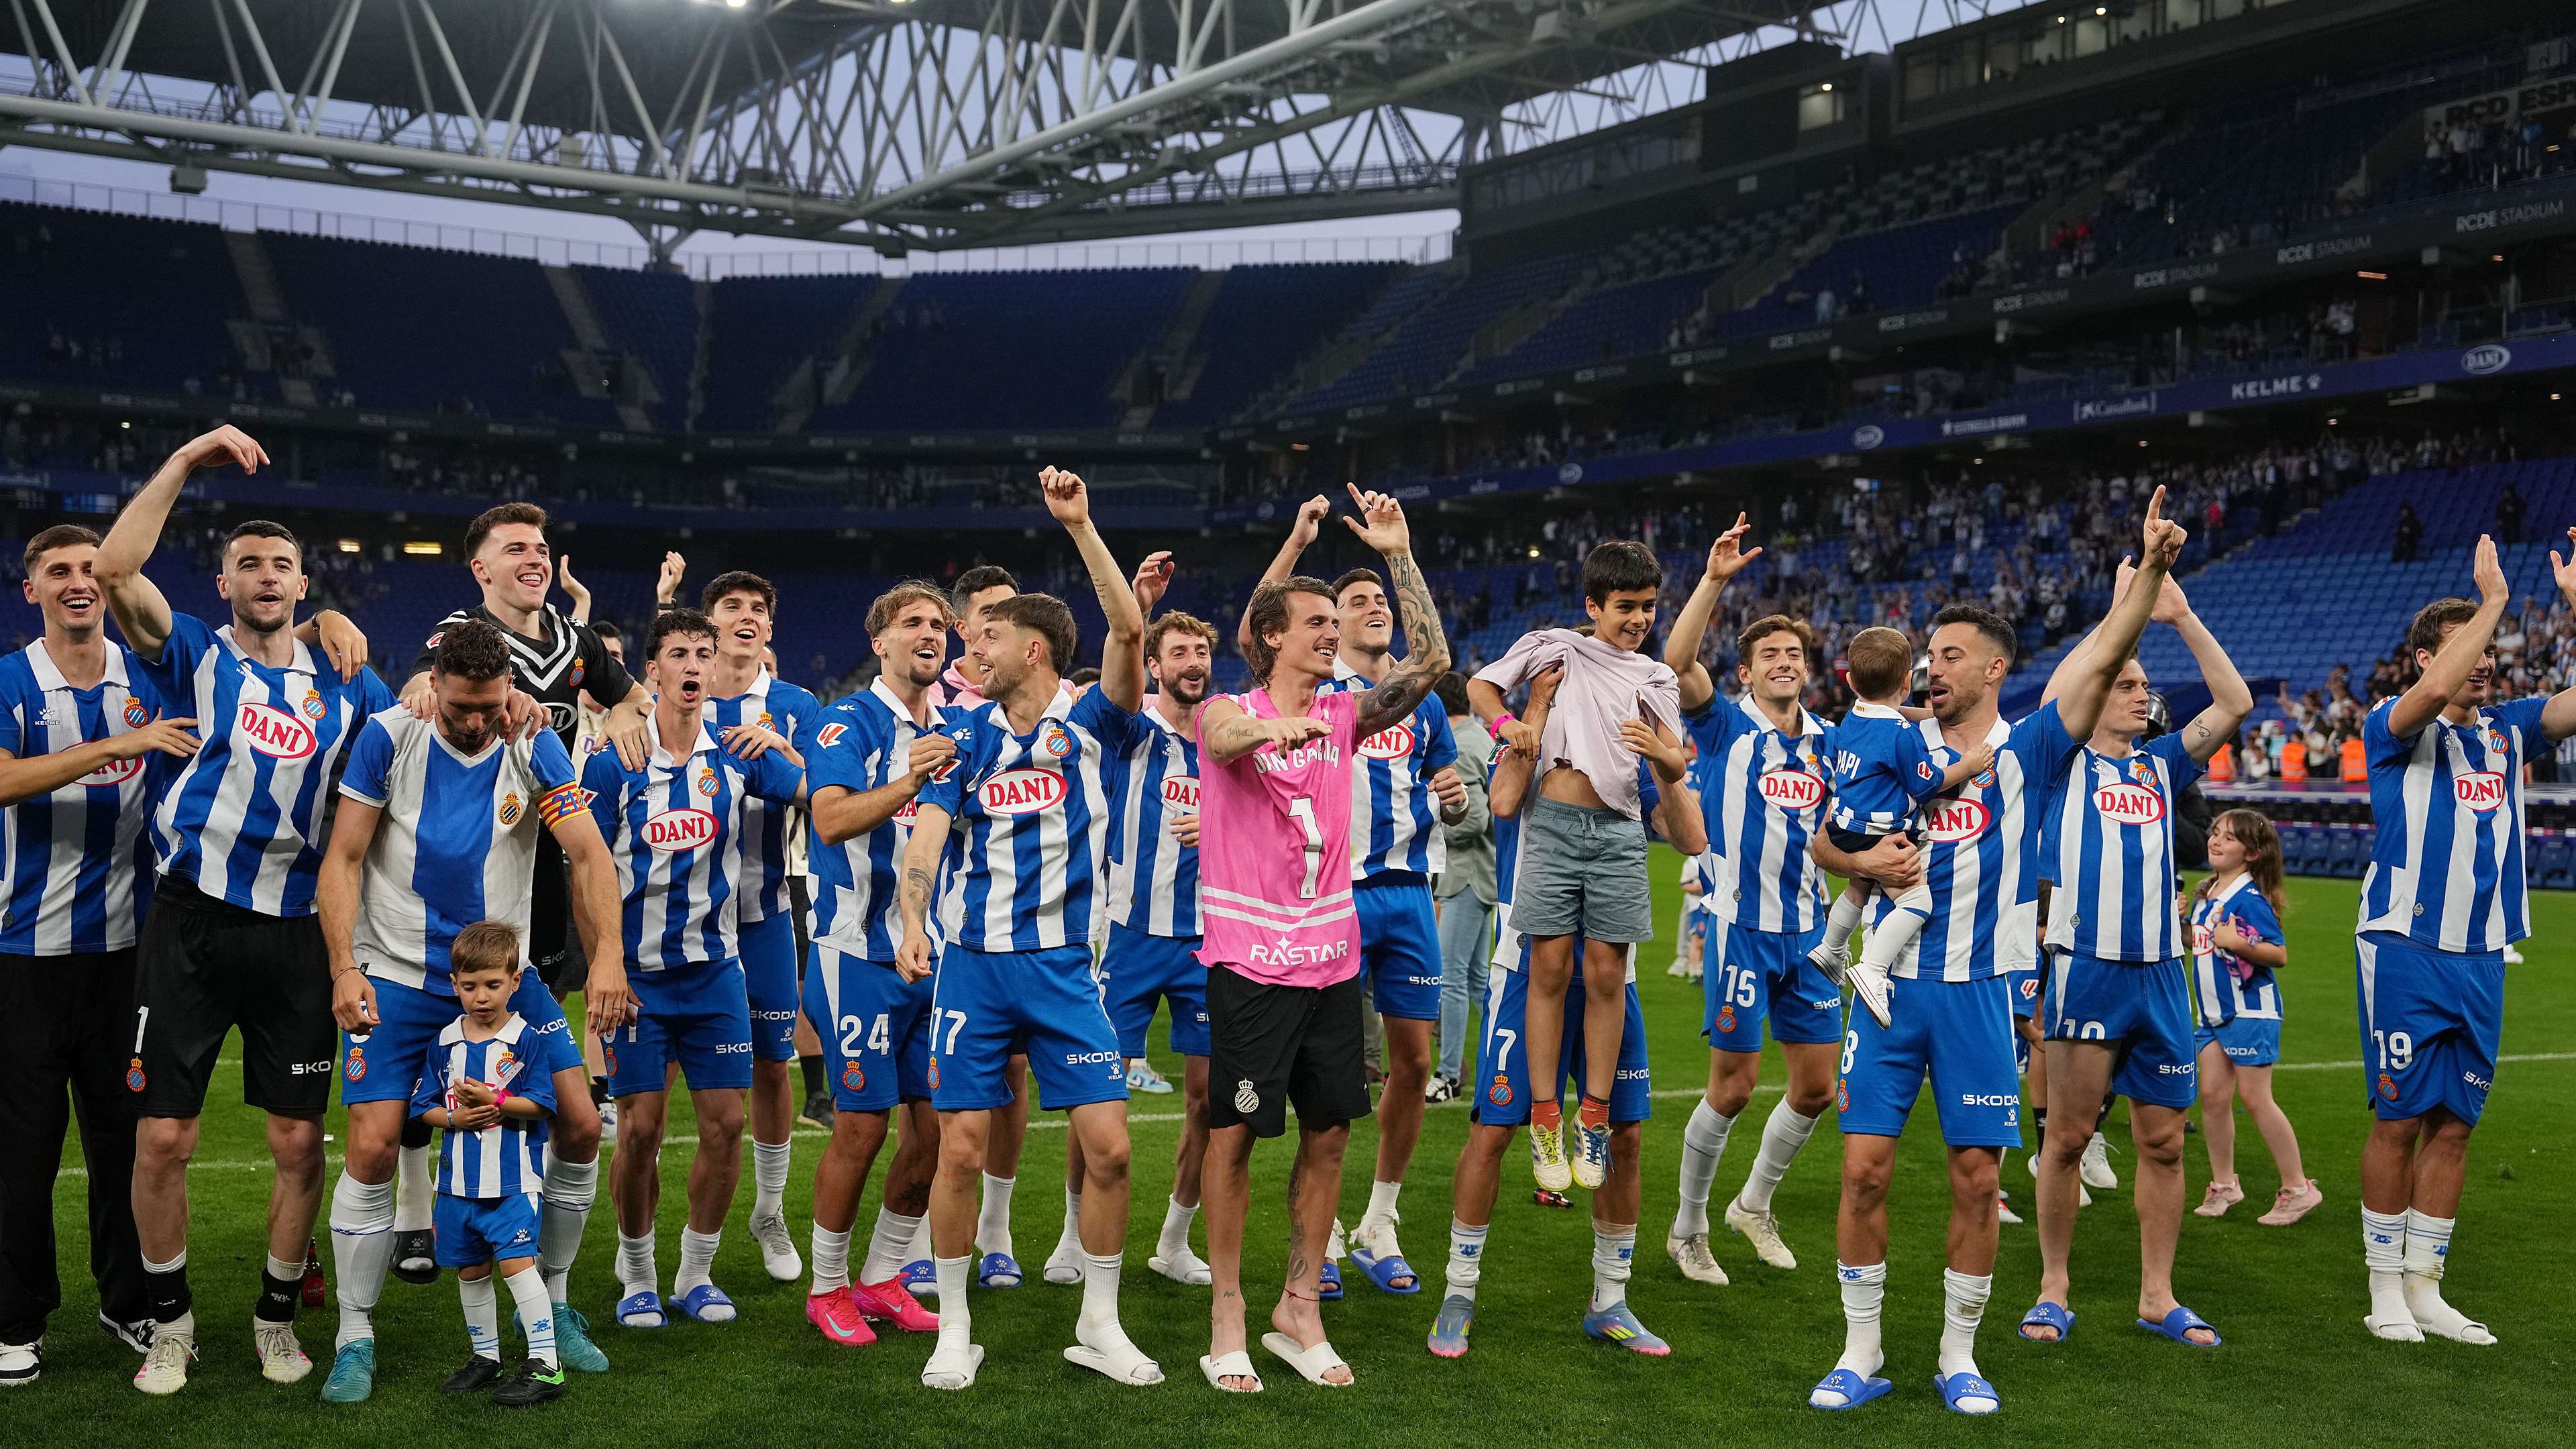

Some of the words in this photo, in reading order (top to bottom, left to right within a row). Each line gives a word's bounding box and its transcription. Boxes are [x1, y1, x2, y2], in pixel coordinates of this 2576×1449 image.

[2456, 210, 2498, 232] RCDE
[2500, 199, 2564, 225] STADIUM
[2277, 241, 2314, 264] RCDE
[2316, 235, 2372, 258] STADIUM
[2231, 375, 2302, 399] KELME
[243, 706, 303, 753] DANI
[1356, 731, 1402, 752] ANI
[1835, 750, 1861, 779] PAPI
[988, 777, 1052, 807] DANI
[1765, 777, 1814, 801] DANI
[2457, 778, 2502, 802] DANI
[552, 790, 578, 816] 21
[2100, 792, 2153, 817] DANI
[649, 817, 706, 844] DANI
[1928, 807, 1974, 832] ANI
[1288, 797, 1323, 899] 1
[1250, 940, 1348, 966] RASTAR
[1725, 965, 1757, 1008] 15
[135, 1006, 149, 1053] 1
[840, 1014, 890, 1057] 24
[931, 1006, 967, 1055] 17
[1067, 1051, 1121, 1065] SKODA
[1495, 1028, 1517, 1071] 7
[1841, 1030, 1859, 1074] 8
[2223, 1046, 2257, 1056] KODA
[2373, 1030, 2412, 1069] 19
[292, 1061, 331, 1075] SKO
[2463, 1071, 2491, 1091] SKO
[1963, 1095, 2020, 1106] SKODA
